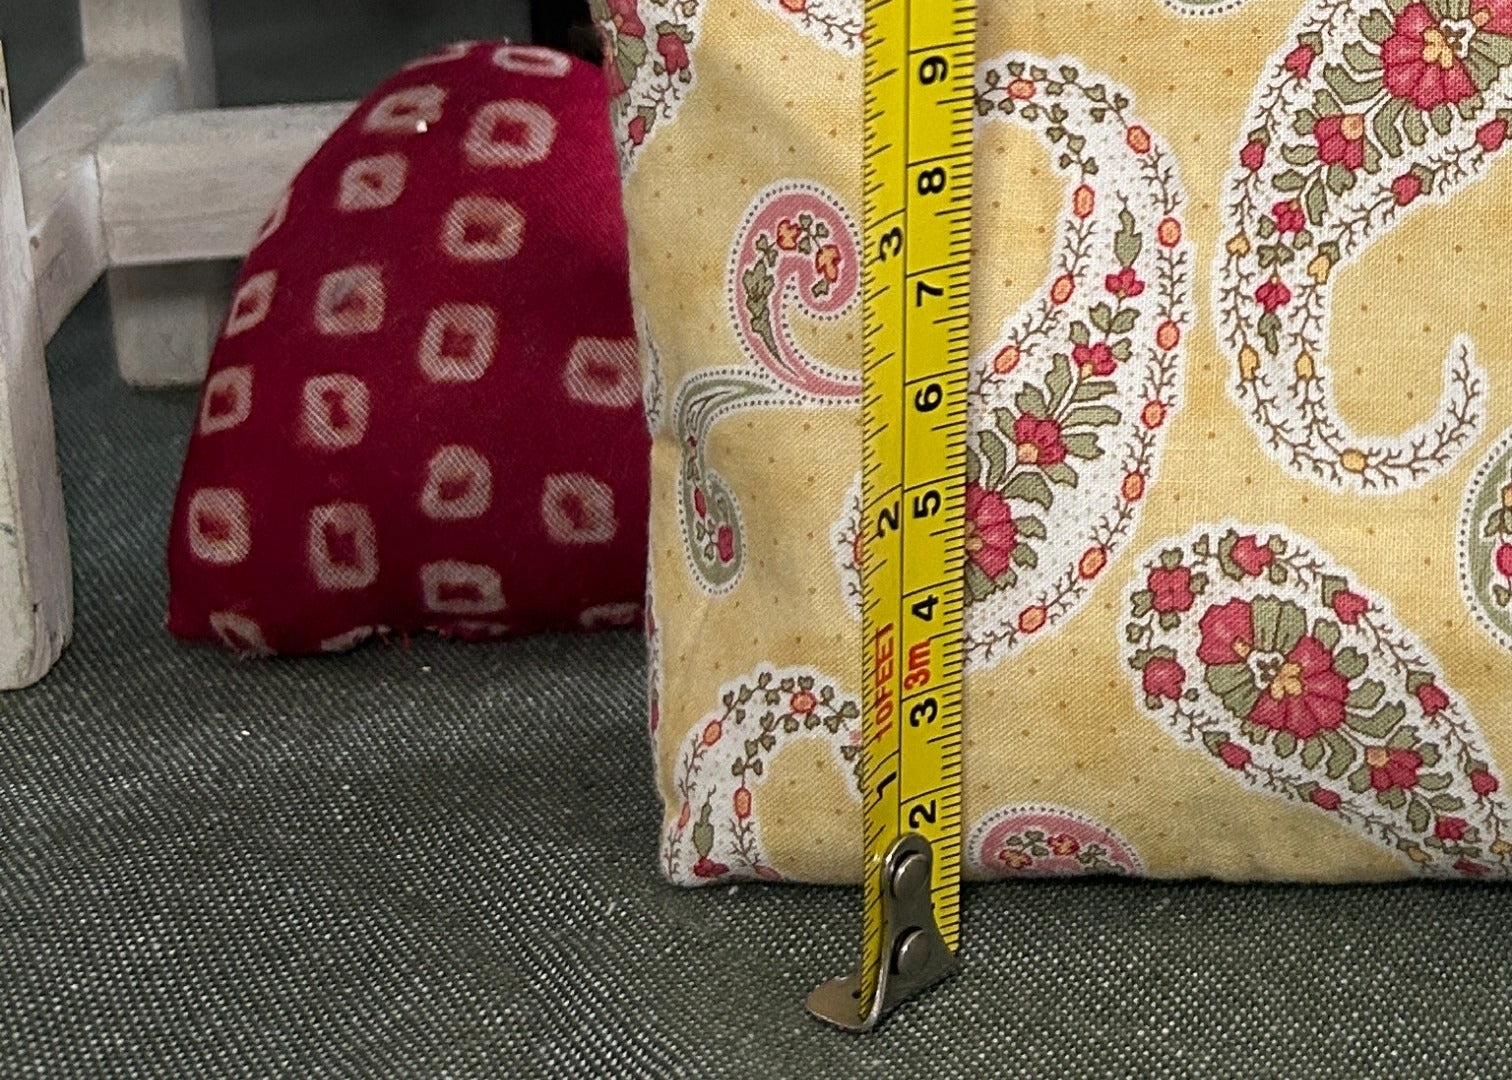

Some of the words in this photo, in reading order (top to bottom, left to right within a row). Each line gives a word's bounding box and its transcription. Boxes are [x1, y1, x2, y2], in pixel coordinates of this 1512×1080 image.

[919, 55, 949, 85] 9
[918, 167, 947, 195] 8
[880, 227, 903, 261] 3
[916, 281, 943, 307] 7
[914, 383, 943, 412] 6
[913, 489, 942, 519] 5
[878, 501, 900, 538] 2
[912, 594, 940, 621] 4
[904, 639, 931, 691] 3m
[910, 697, 938, 728] 3
[877, 771, 897, 800] 1
[909, 799, 936, 829] 2
